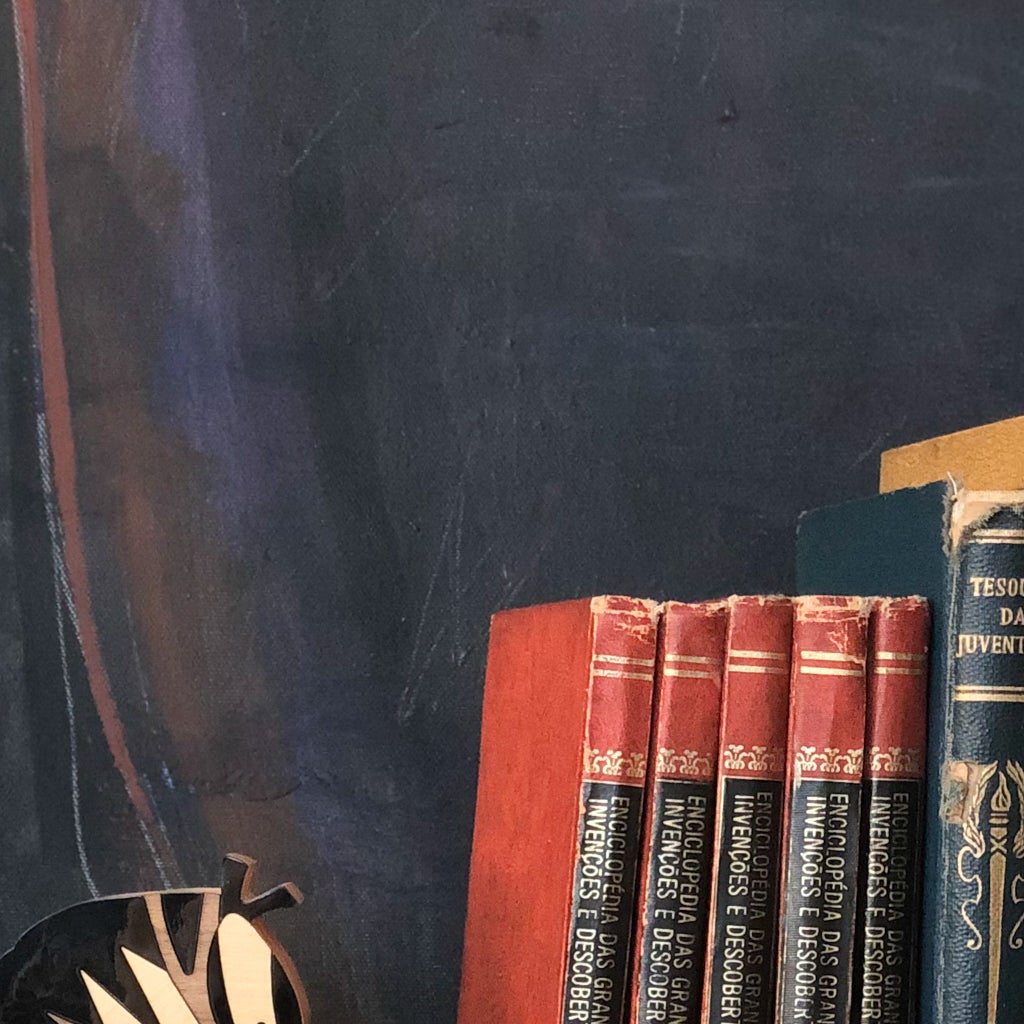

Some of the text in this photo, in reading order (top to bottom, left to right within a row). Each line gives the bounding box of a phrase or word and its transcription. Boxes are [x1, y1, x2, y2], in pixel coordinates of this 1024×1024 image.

[579, 799, 608, 900] INVENÇÕES
[600, 796, 630, 924] ENCICLOPÉDIA
[656, 799, 685, 899] INVENÇÕES
[728, 795, 754, 896] INVENÇÕES
[800, 796, 827, 898] INVENÇÕES
[823, 794, 849, 921] ENCICLOPÉDIA
[577, 909, 597, 919] E
[655, 909, 675, 920] E
[726, 905, 747, 916] E
[799, 907, 819, 917] E
[866, 907, 886, 917] E
[596, 933, 618, 969] DAS
[673, 933, 696, 969] DAS
[747, 930, 765, 965] DAS
[820, 931, 841, 967] DAS
[886, 930, 904, 966] DAS
